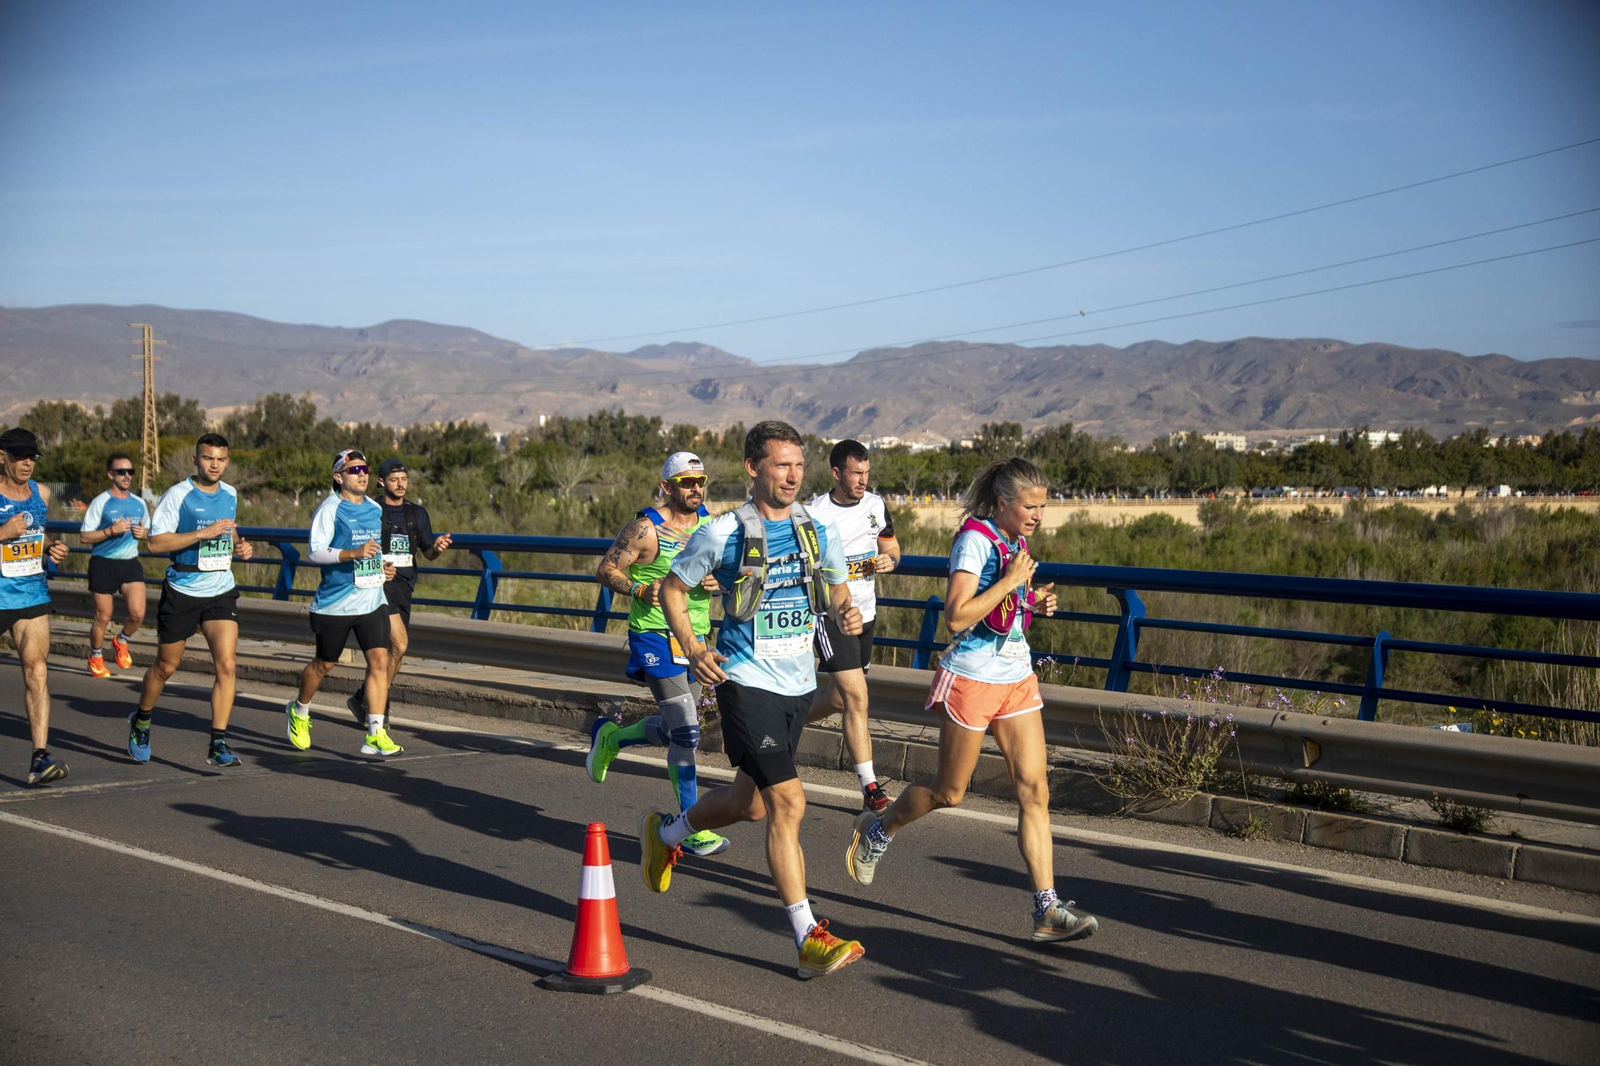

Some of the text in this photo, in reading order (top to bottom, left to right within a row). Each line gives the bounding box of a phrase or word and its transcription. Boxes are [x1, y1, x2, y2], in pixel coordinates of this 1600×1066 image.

[12, 542, 36, 556] 911
[359, 560, 381, 571] 1108
[764, 609, 812, 630] 1682
